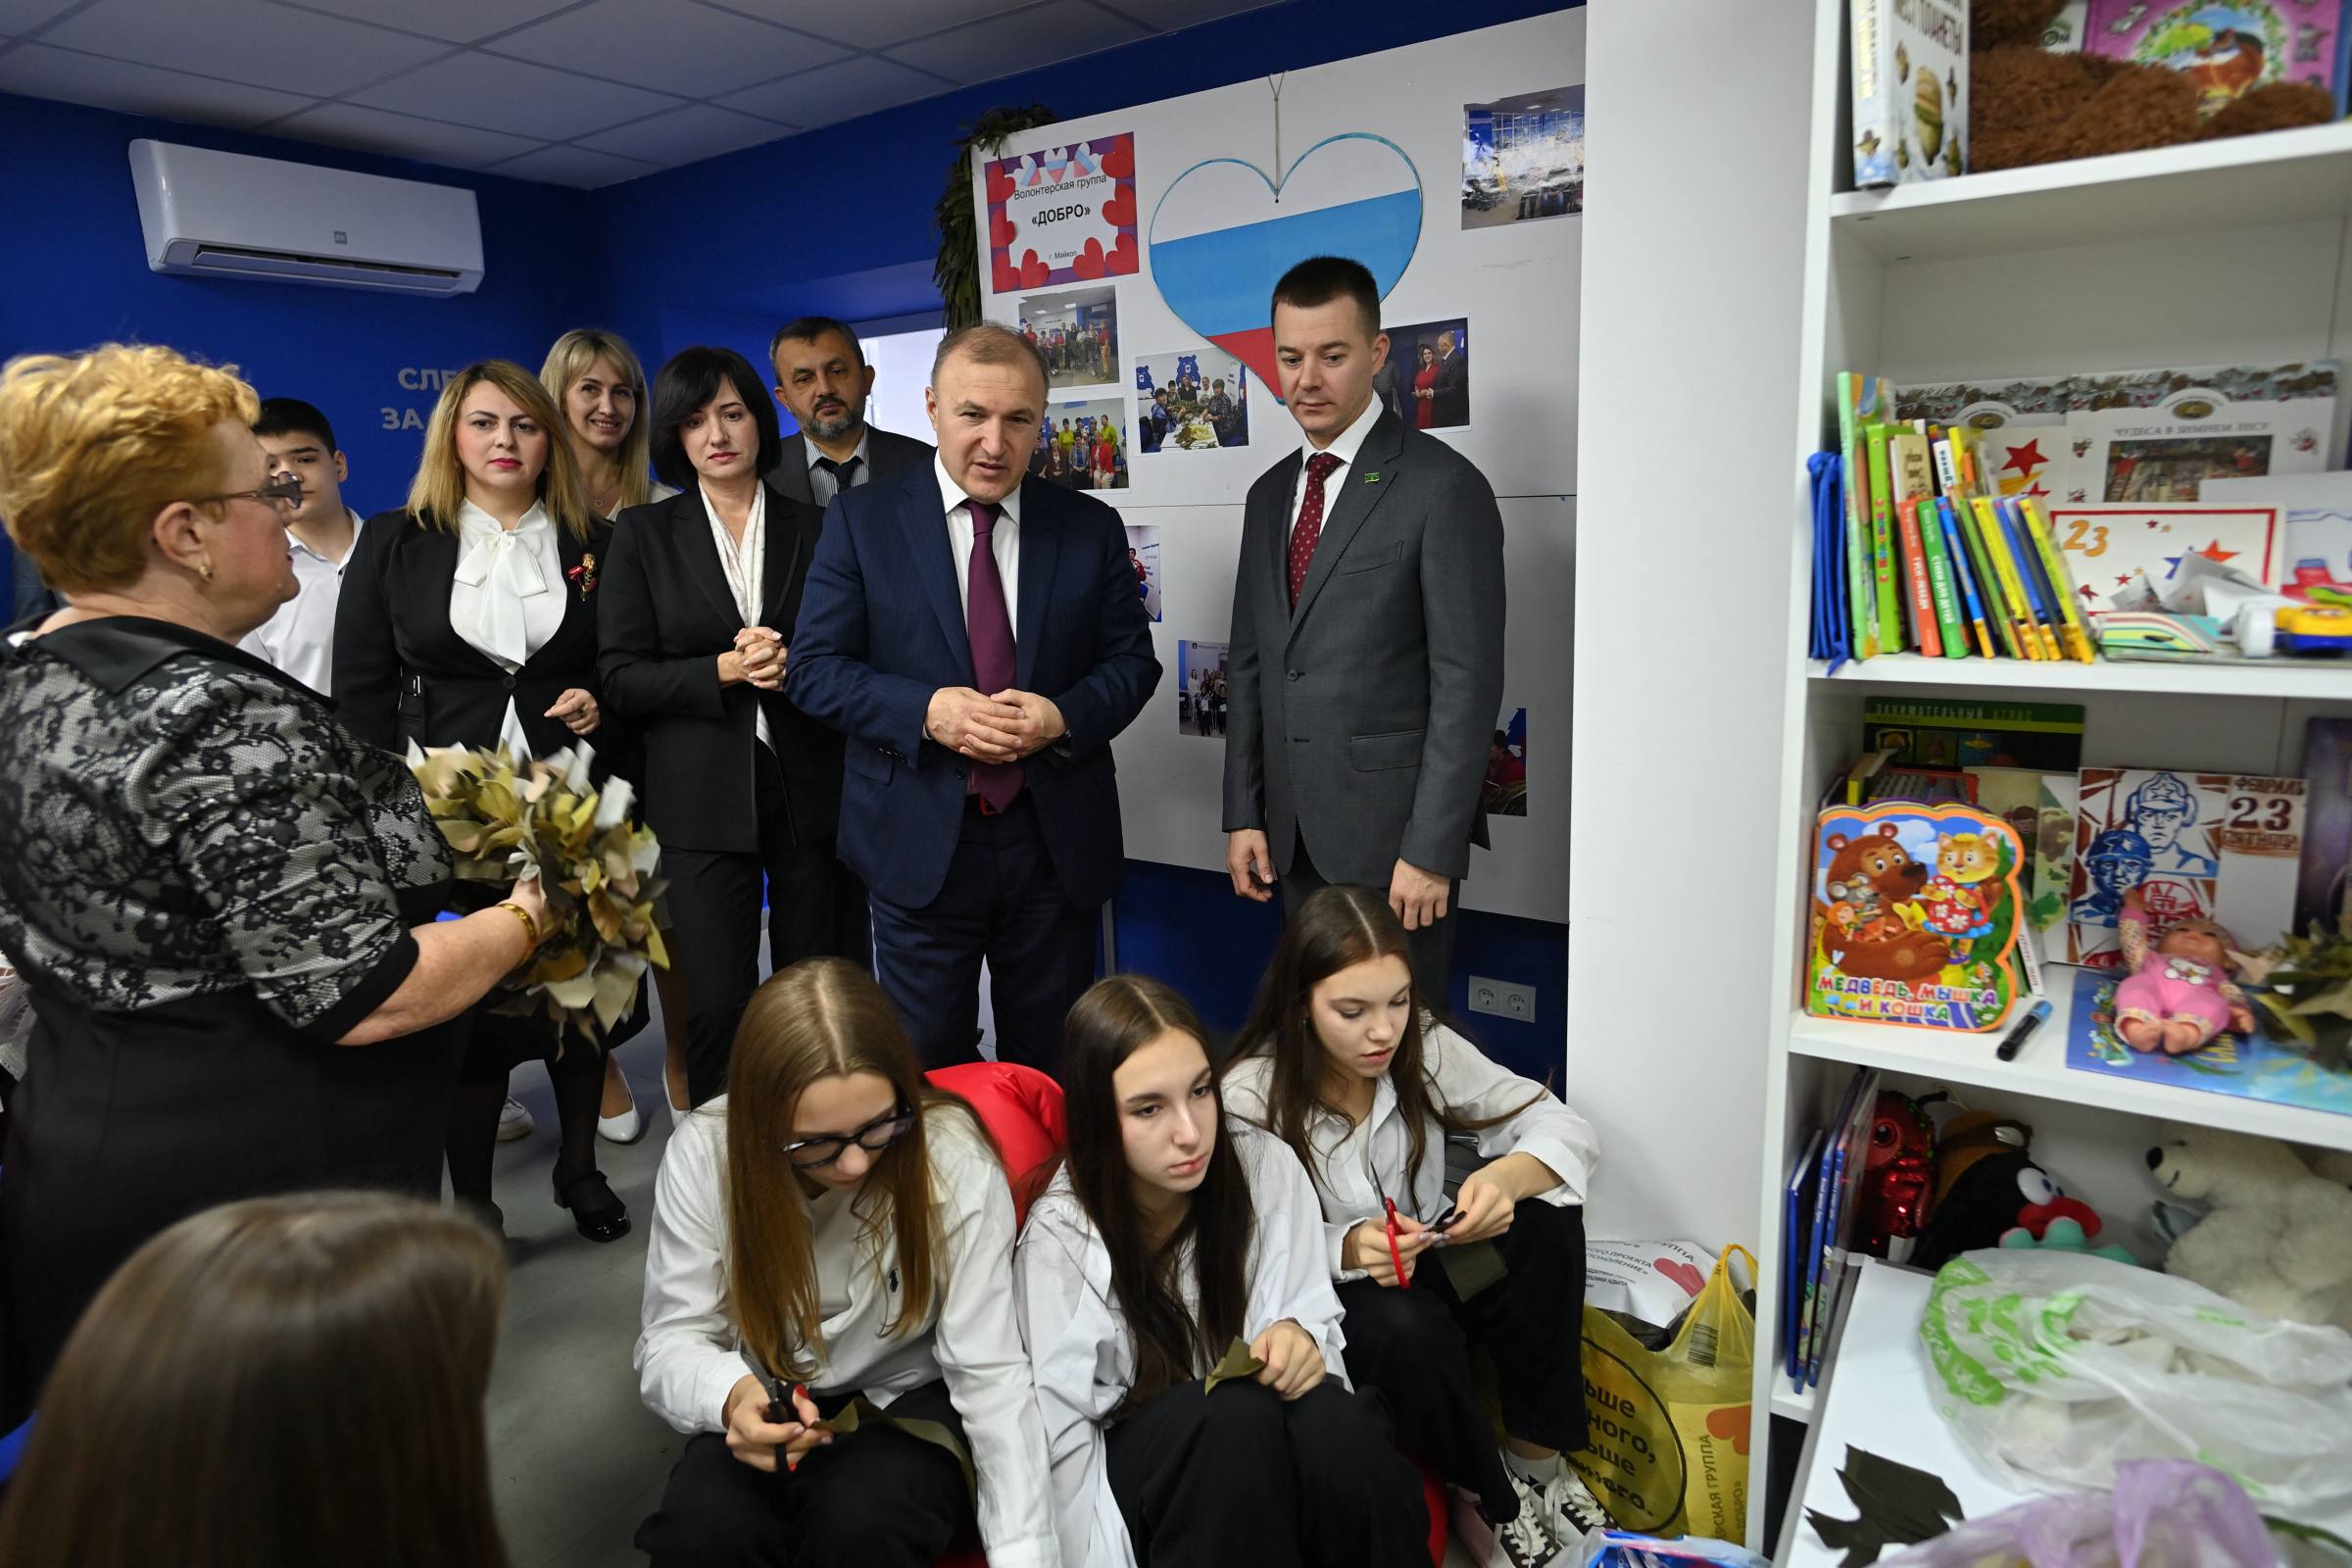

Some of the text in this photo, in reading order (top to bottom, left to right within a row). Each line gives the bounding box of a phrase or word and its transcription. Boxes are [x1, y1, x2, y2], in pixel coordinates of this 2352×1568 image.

[1014, 174, 1107, 200] Волонтерская группа
[1031, 204, 1091, 227] «ДОБРО»
[380, 407, 424, 430] ЗА
[2063, 518, 2109, 558] 23
[2230, 796, 2292, 831] 23
[1817, 975, 1998, 1005] МЕДВЕДЬ, МЫШКА
[1858, 998, 1950, 1020] И КОШКА
[1609, 1250, 1652, 1268] ПРОЕКТА
[1698, 1434, 1720, 1489] ГРУППА
